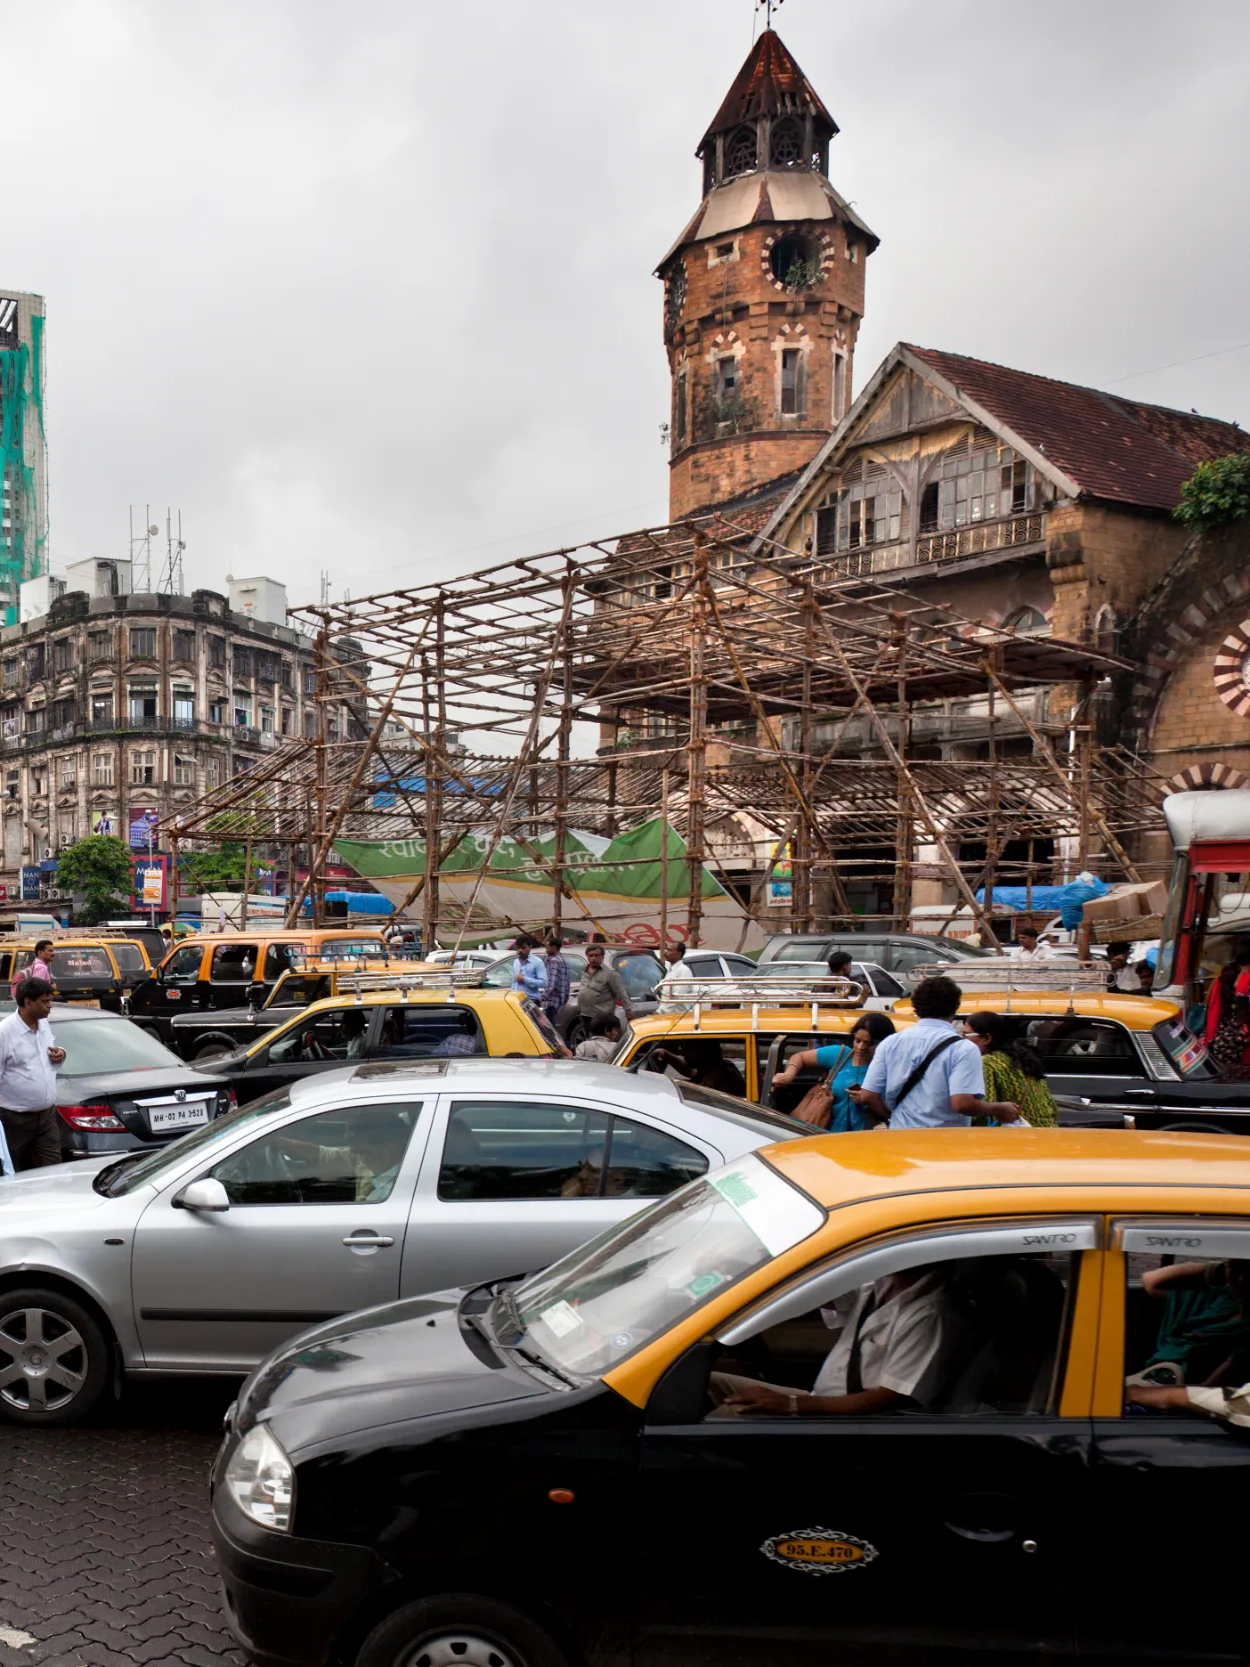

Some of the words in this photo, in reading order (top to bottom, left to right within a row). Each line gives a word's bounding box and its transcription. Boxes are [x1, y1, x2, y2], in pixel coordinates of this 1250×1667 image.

[154, 1114, 164, 1122] MH
[1022, 1233, 1077, 1246] SANTRO
[1146, 1236, 1202, 1248] SANTRO
[787, 1544, 853, 1558] 95.E.470
